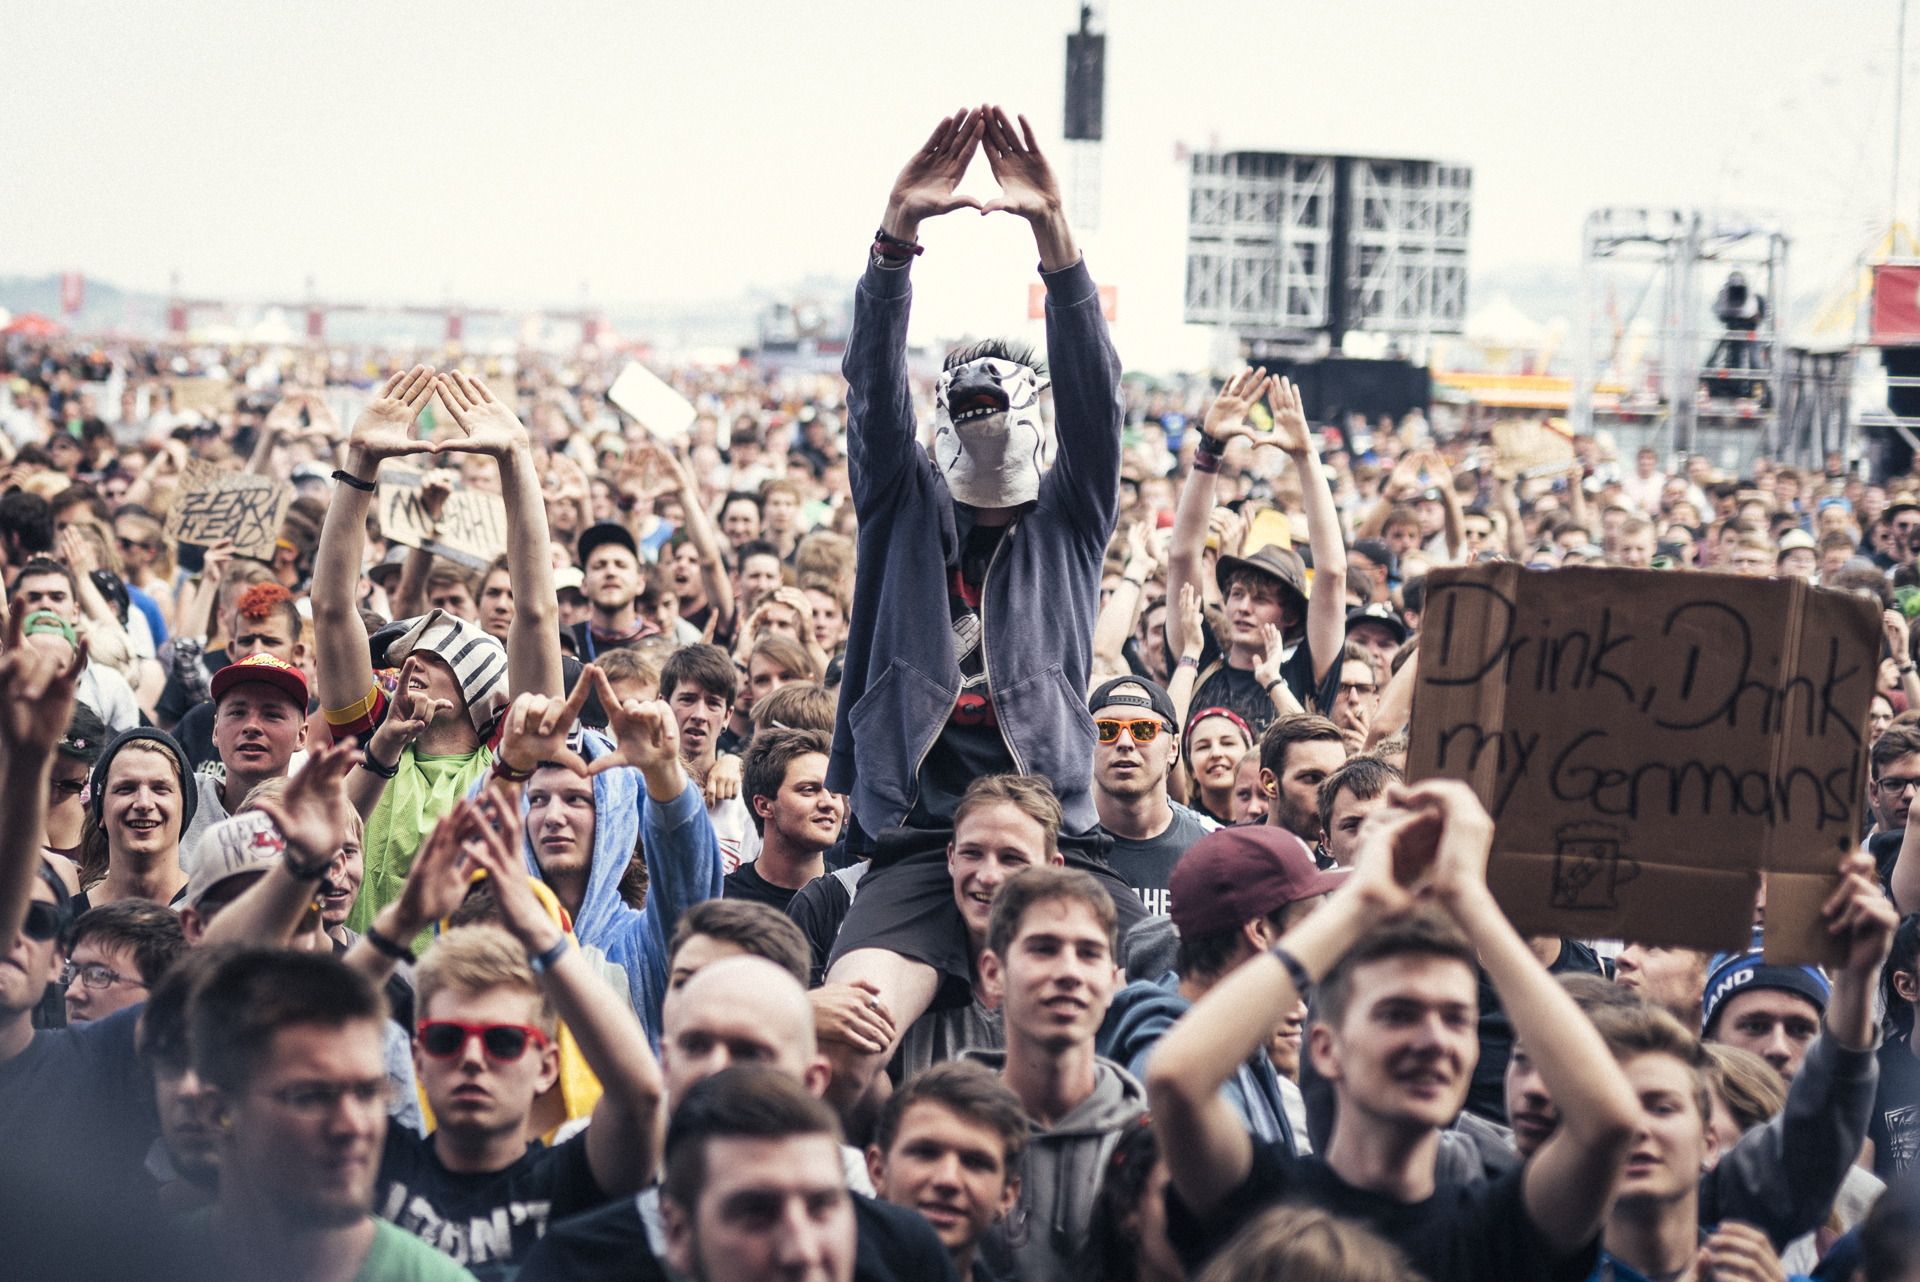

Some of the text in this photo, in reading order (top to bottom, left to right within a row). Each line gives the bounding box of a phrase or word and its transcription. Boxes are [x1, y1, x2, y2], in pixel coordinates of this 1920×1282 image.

[177, 515, 267, 548] HEAD
[182, 488, 282, 527] ZEBRA
[1425, 582, 1864, 745] Drink, Drink
[1436, 723, 1862, 853] my Germans!
[404, 1196, 552, 1268] DON'T
